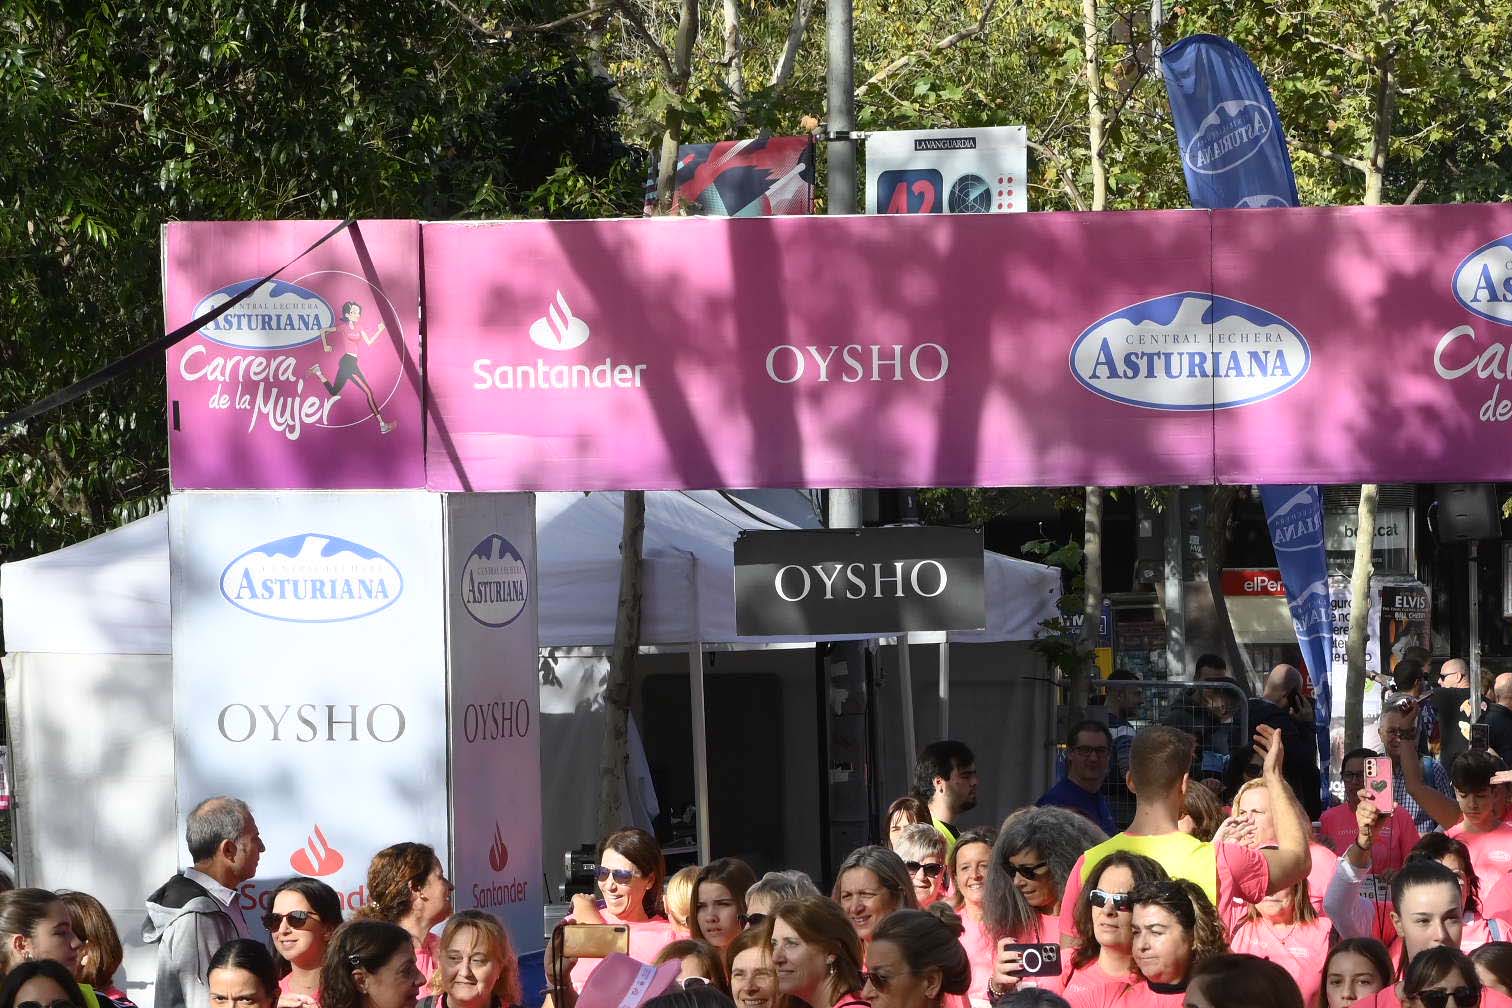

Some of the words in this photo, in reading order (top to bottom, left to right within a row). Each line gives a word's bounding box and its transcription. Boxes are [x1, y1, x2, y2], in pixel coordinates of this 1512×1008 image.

[1088, 336, 1293, 381] ASTURIANA
[1125, 334, 1203, 346] CENTRAL
[1208, 332, 1285, 344] LECHERA
[179, 344, 298, 383] Carrera
[473, 358, 647, 391] Santander
[765, 343, 950, 385] OYSHO
[208, 384, 231, 410] de
[235, 384, 251, 411] la
[248, 379, 342, 441] Mujer
[1479, 383, 1512, 423] de
[234, 567, 390, 600] ASTURIANA
[466, 568, 526, 604] ASTURIANA
[774, 559, 949, 602] OYSHO
[1395, 596, 1425, 609] ELVIS
[217, 703, 406, 743] OYSHO
[464, 698, 530, 743] OYSHO
[472, 877, 528, 909] Santander
